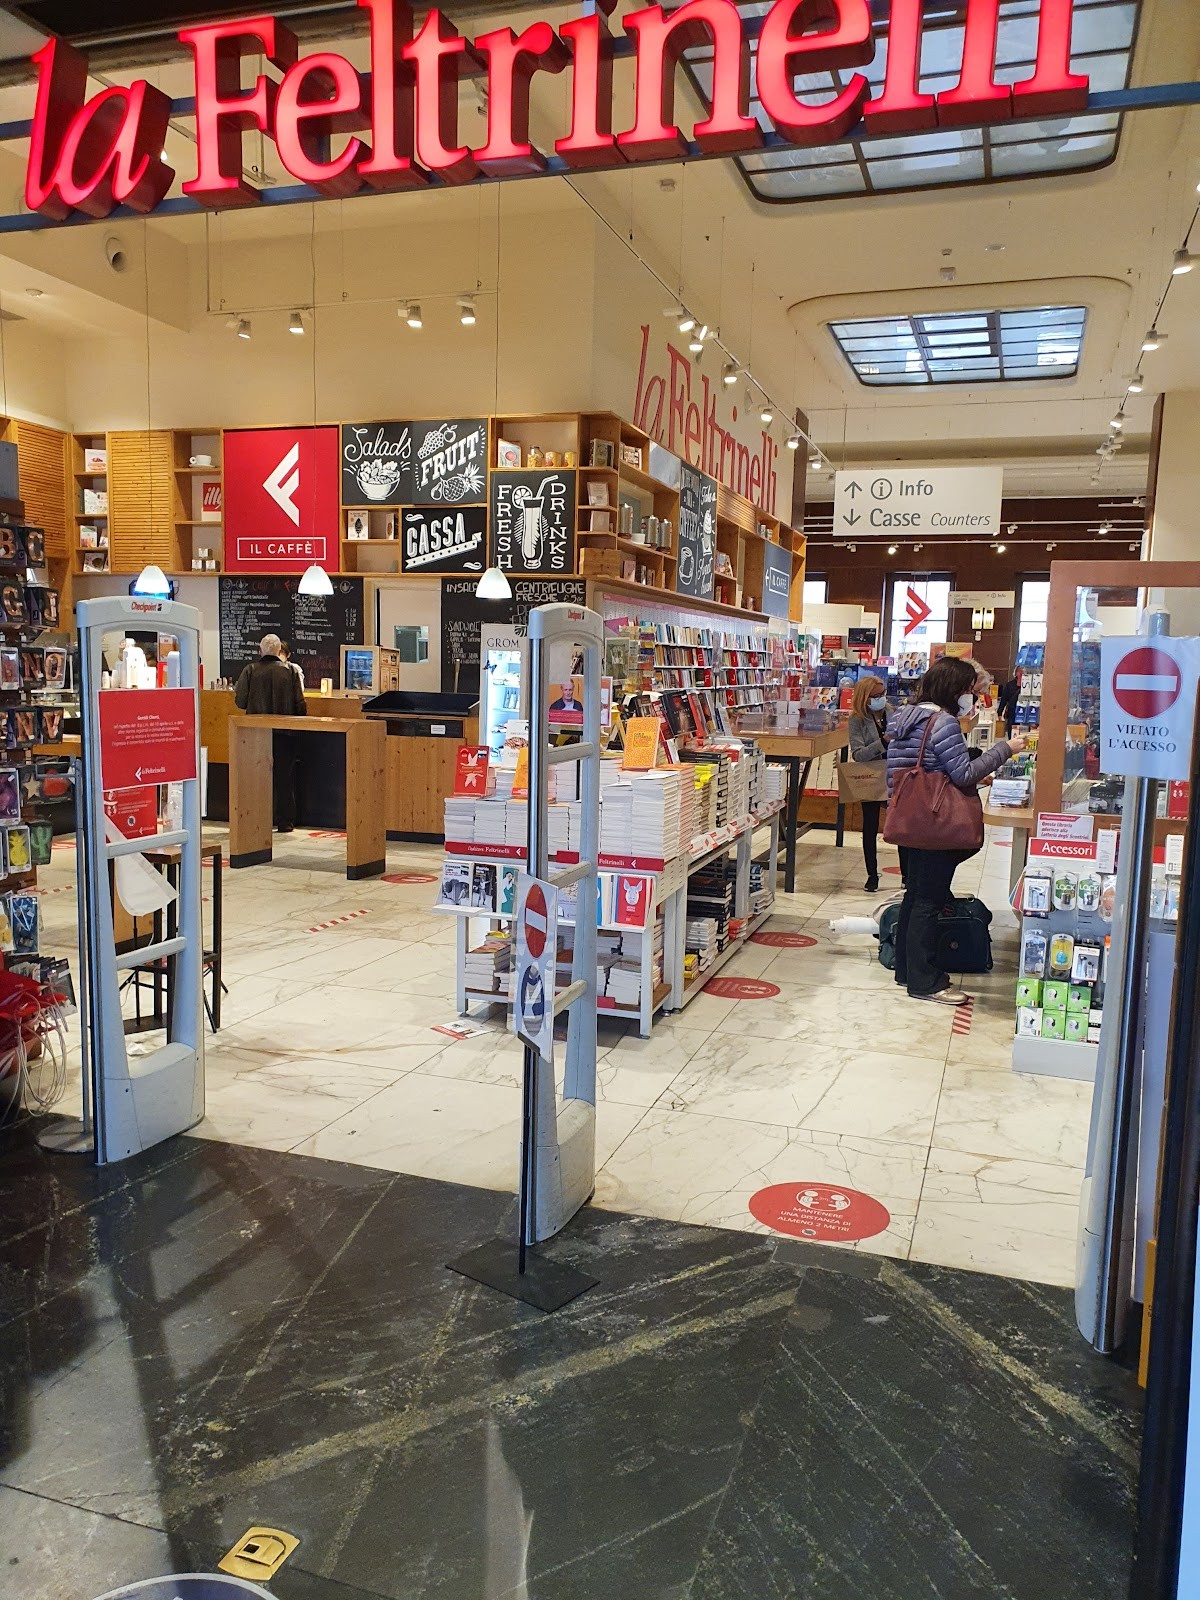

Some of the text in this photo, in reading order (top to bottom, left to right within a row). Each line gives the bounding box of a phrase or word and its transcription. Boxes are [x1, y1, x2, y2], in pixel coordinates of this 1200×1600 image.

[26, 0, 1089, 214] la Feltrinelli
[344, 426, 412, 463] Salads
[420, 428, 480, 487] FRUIT
[899, 480, 933, 496] Info
[869, 508, 991, 527] Casse Counters
[496, 484, 513, 569] FRESH
[549, 483, 568, 569] DRINKS
[406, 512, 467, 558] CASSA
[250, 541, 312, 554] IL CAFFÈ
[446, 581, 478, 594] INSALA
[515, 593, 558, 602] FRESCHE
[486, 638, 519, 648] GROM
[1117, 724, 1170, 737] VIETATO
[1108, 739, 1177, 753] L'ACCESSO
[485, 846, 510, 854] Feltrinelli
[1041, 842, 1093, 856] Accessori
[780, 1210, 799, 1218] UNA
[801, 1214, 841, 1225] DISTANZA
[793, 1207, 844, 1219] MANTENERE
[777, 1216, 814, 1226] ALMENO
[823, 1223, 850, 1232] METRI
